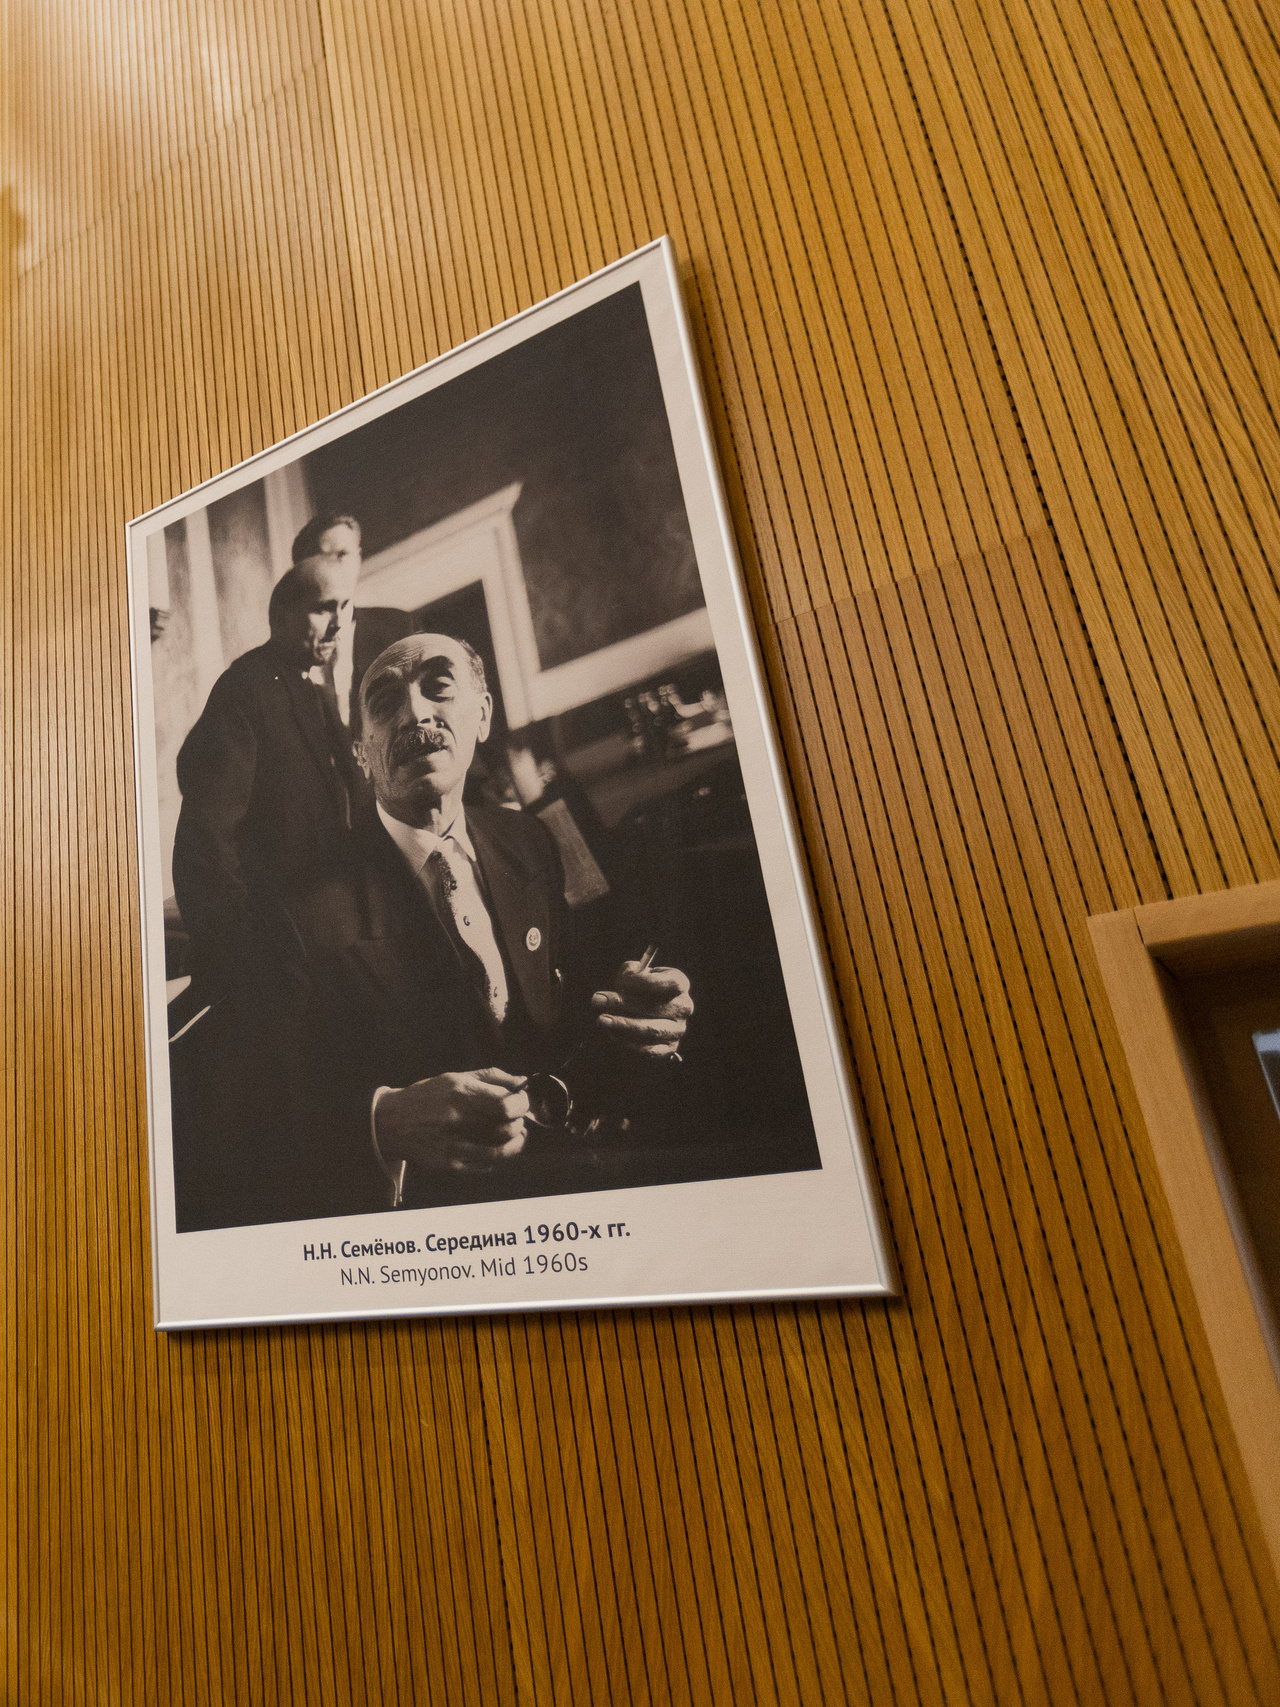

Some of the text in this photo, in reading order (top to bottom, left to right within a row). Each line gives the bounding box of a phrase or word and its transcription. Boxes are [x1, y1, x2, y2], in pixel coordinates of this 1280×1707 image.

[303, 1221, 631, 1261] Н.Н. Семёнов. Середина 1960-х гг.
[340, 1252, 589, 1287] N.N. Semyonov. Mid 1960s
